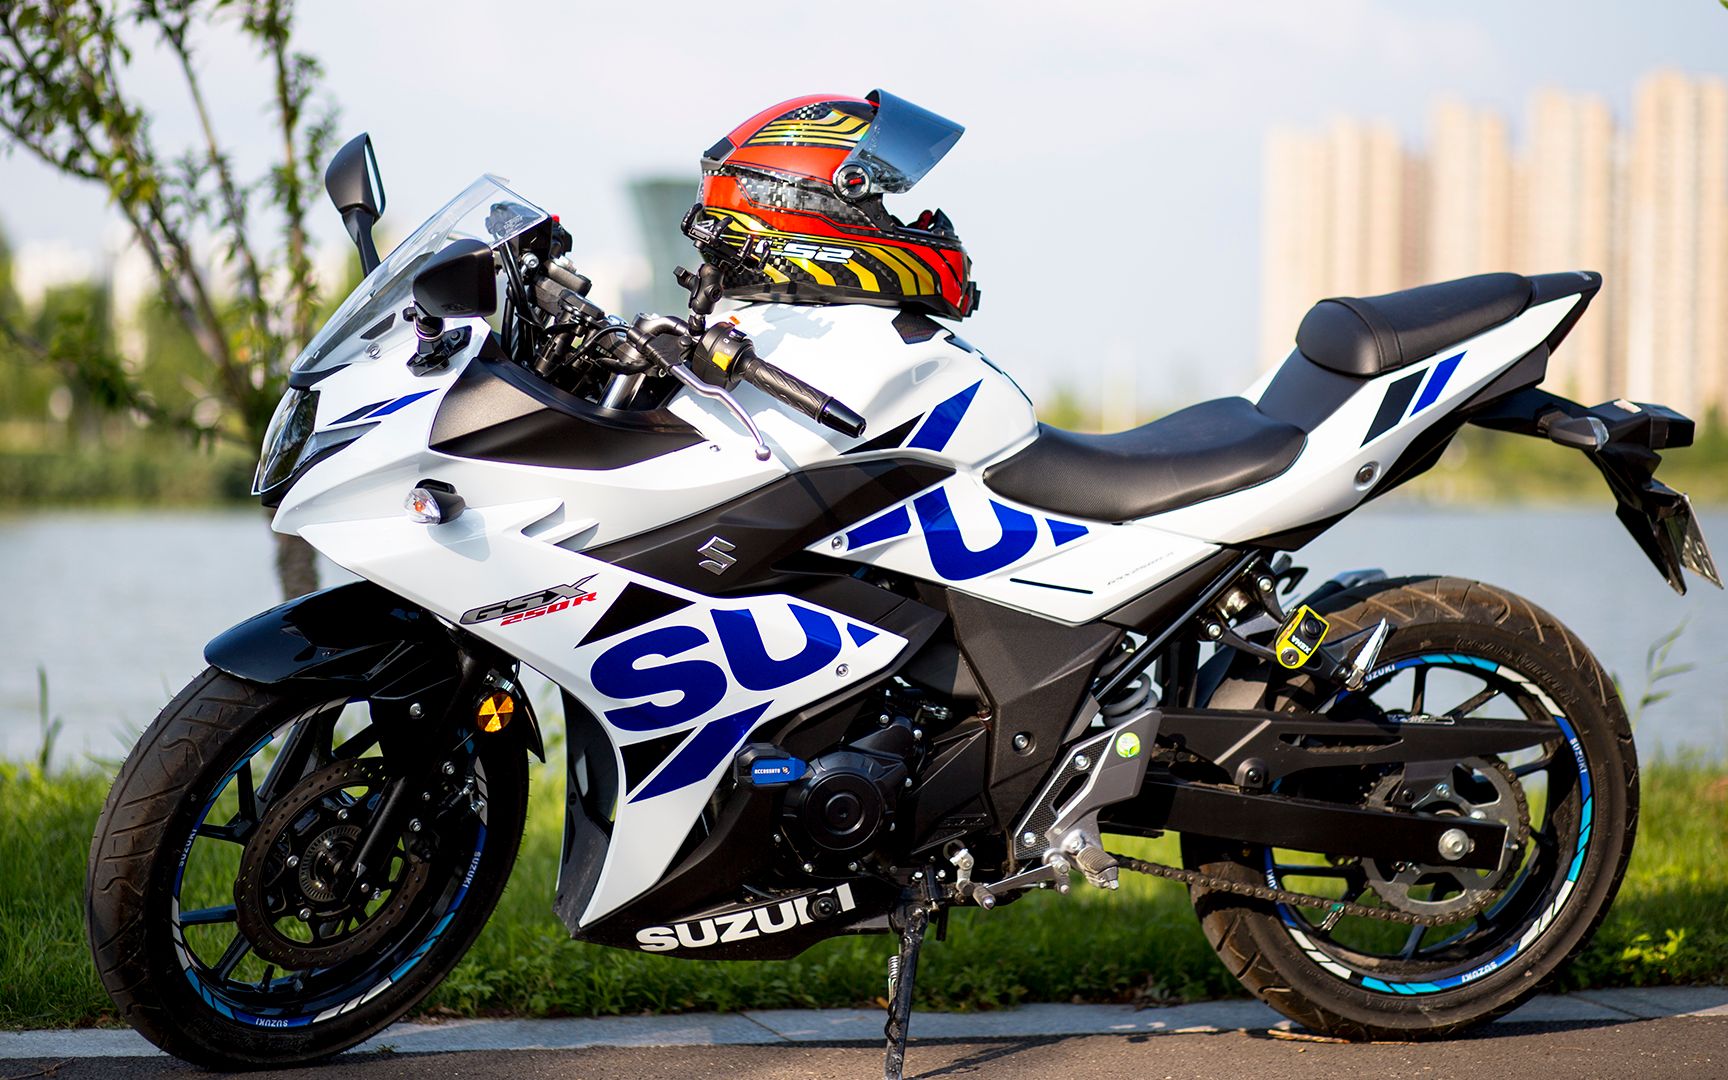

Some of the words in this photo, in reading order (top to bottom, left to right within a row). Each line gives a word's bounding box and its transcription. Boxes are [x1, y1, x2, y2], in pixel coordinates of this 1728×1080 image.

[459, 572, 600, 625] GSX
[1364, 664, 1396, 682] UZUKI
[1569, 737, 1588, 774] SUZUKI
[178, 829, 197, 867] SUZUKI
[462, 851, 481, 888] SUZUKI
[1461, 961, 1498, 983] SUZUKI
[255, 1018, 289, 1028] SUZUKI
